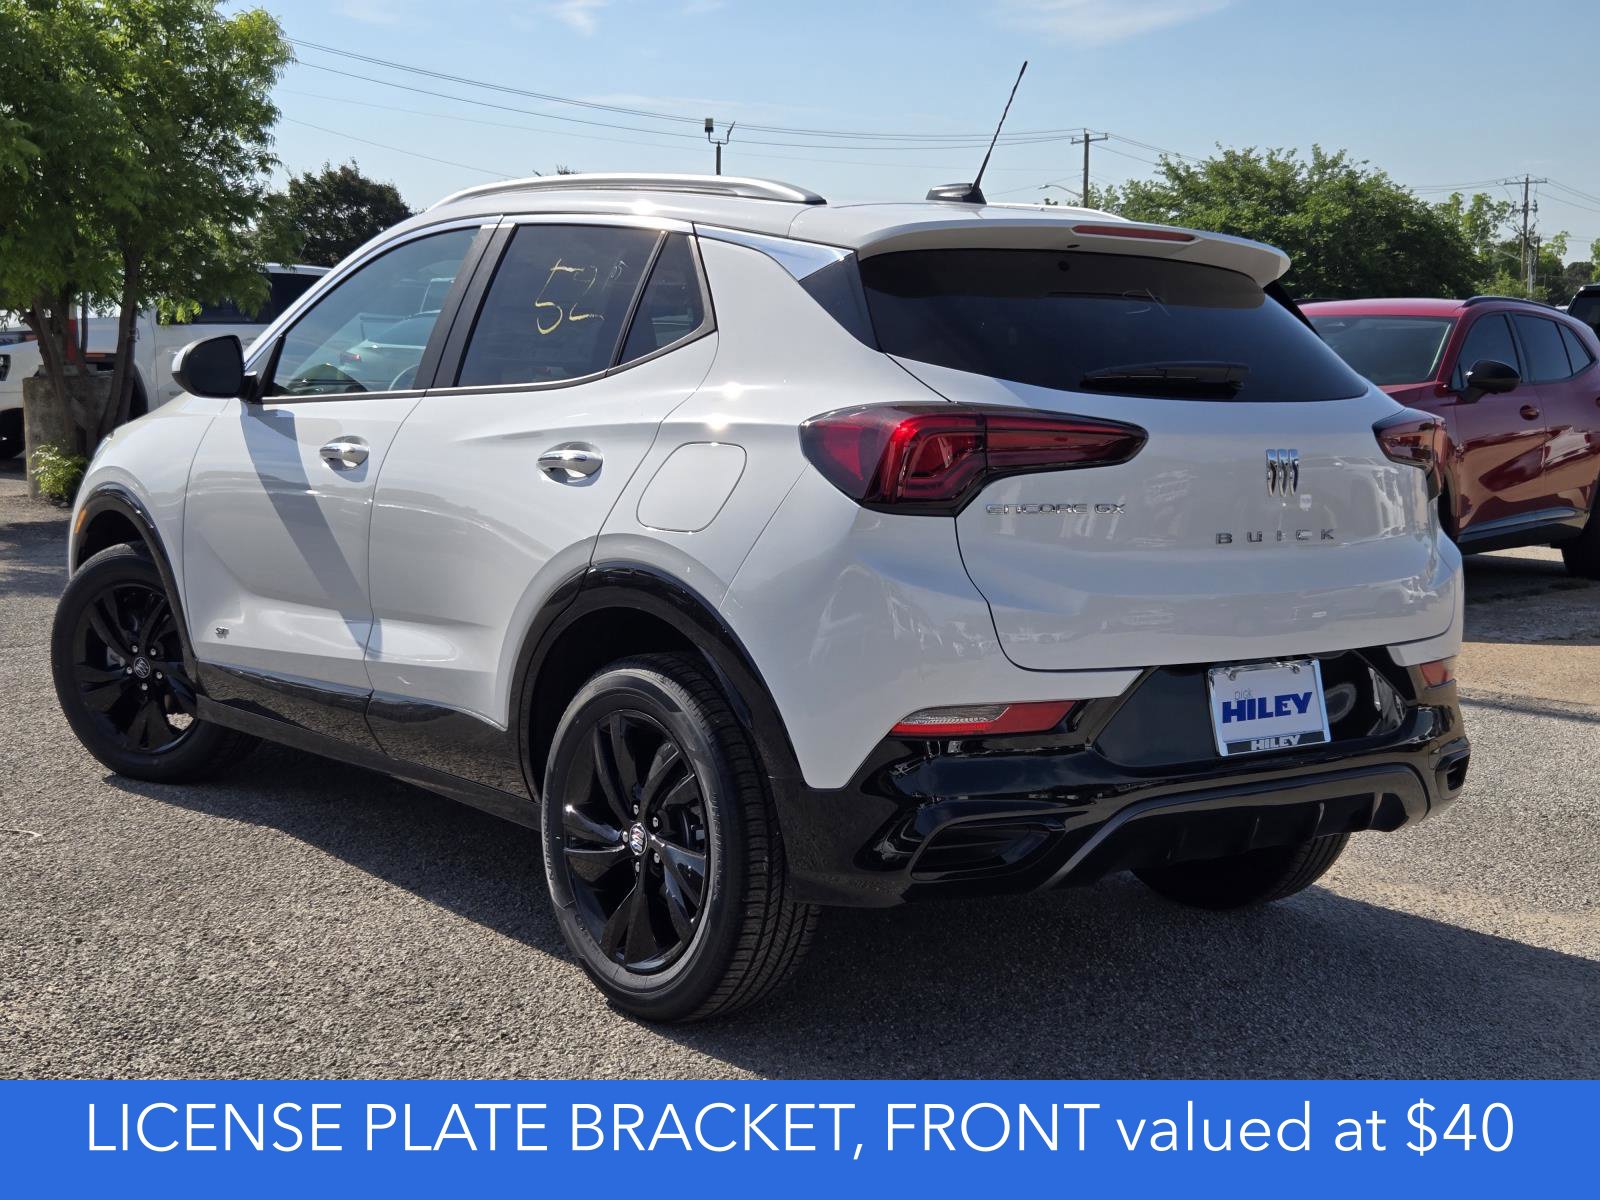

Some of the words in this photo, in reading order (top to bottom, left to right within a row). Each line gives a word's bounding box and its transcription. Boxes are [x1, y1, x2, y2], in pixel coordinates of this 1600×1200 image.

[985, 502, 1088, 515] ENCORE
[1093, 502, 1126, 514] GX
[1215, 528, 1335, 545] BUICK
[1221, 691, 1313, 724] HILEY
[1250, 734, 1301, 751] HILEY
